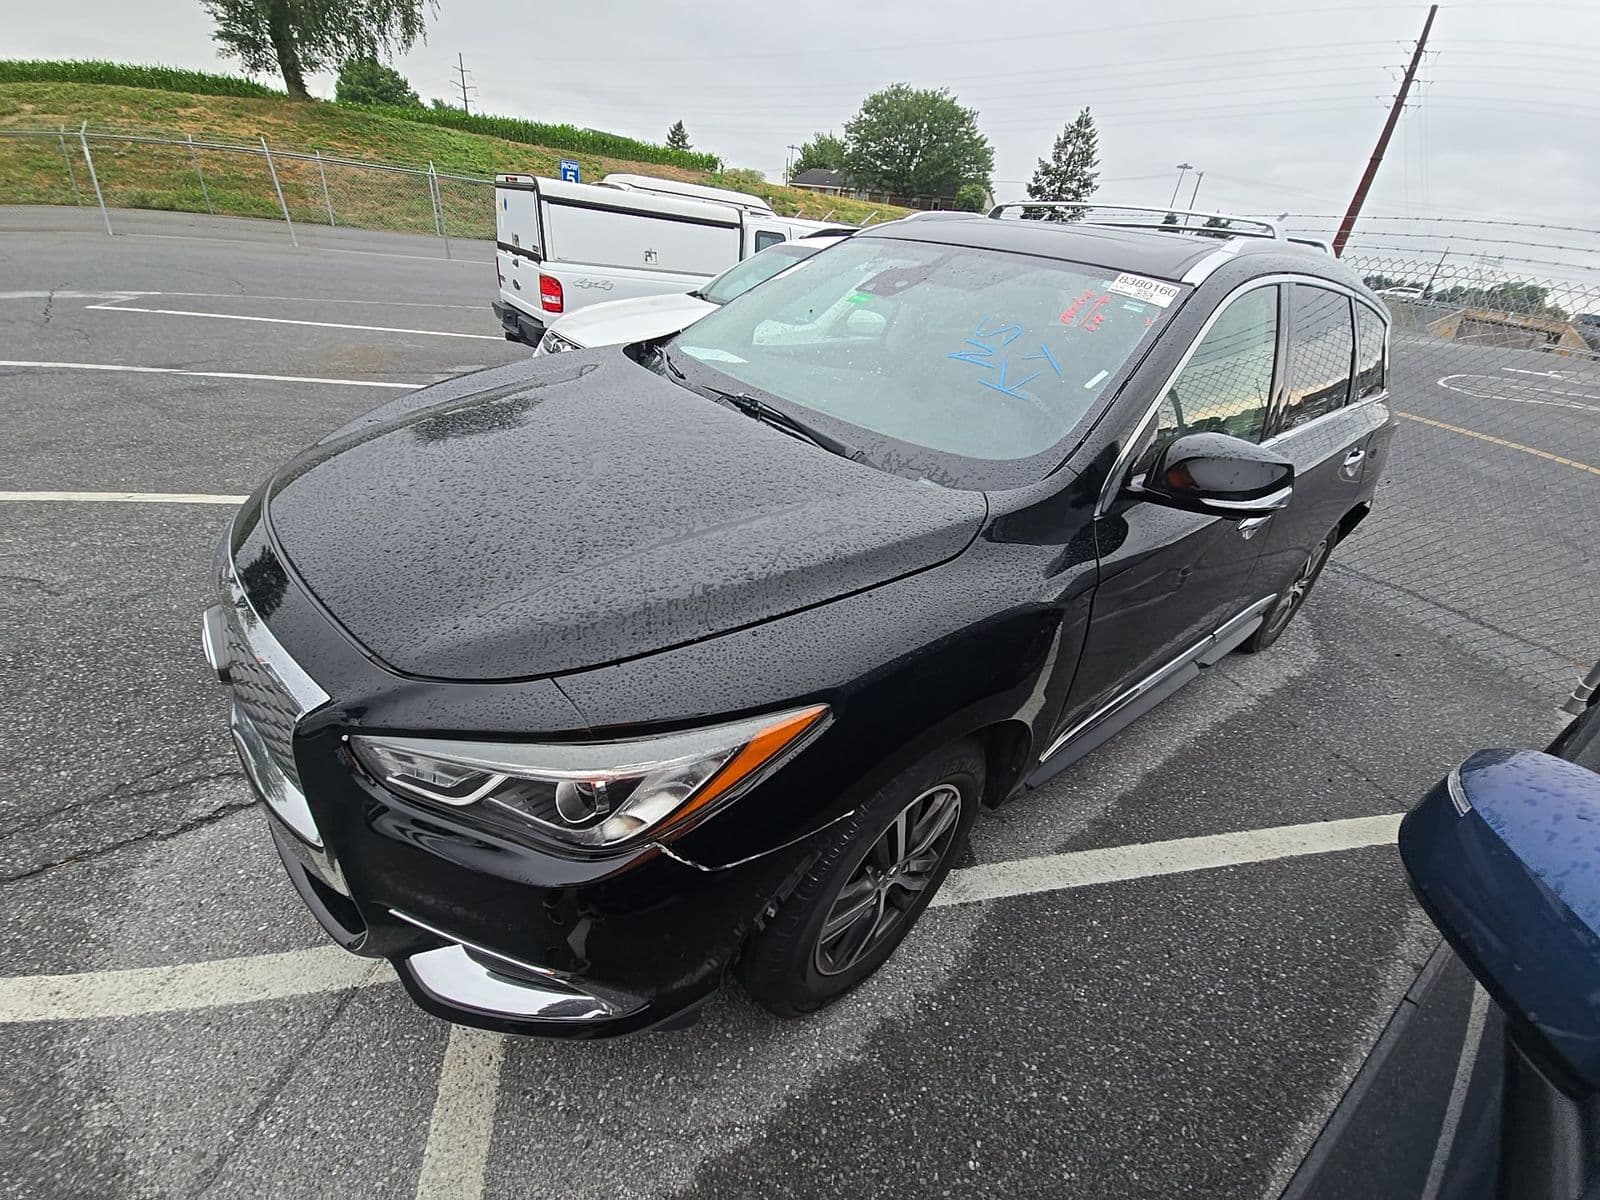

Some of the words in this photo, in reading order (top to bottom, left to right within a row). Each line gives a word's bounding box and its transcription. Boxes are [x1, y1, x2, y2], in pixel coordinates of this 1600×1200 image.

[562, 161, 578, 170] ROW
[566, 170, 576, 183] 5
[1118, 275, 1178, 298] 8380160
